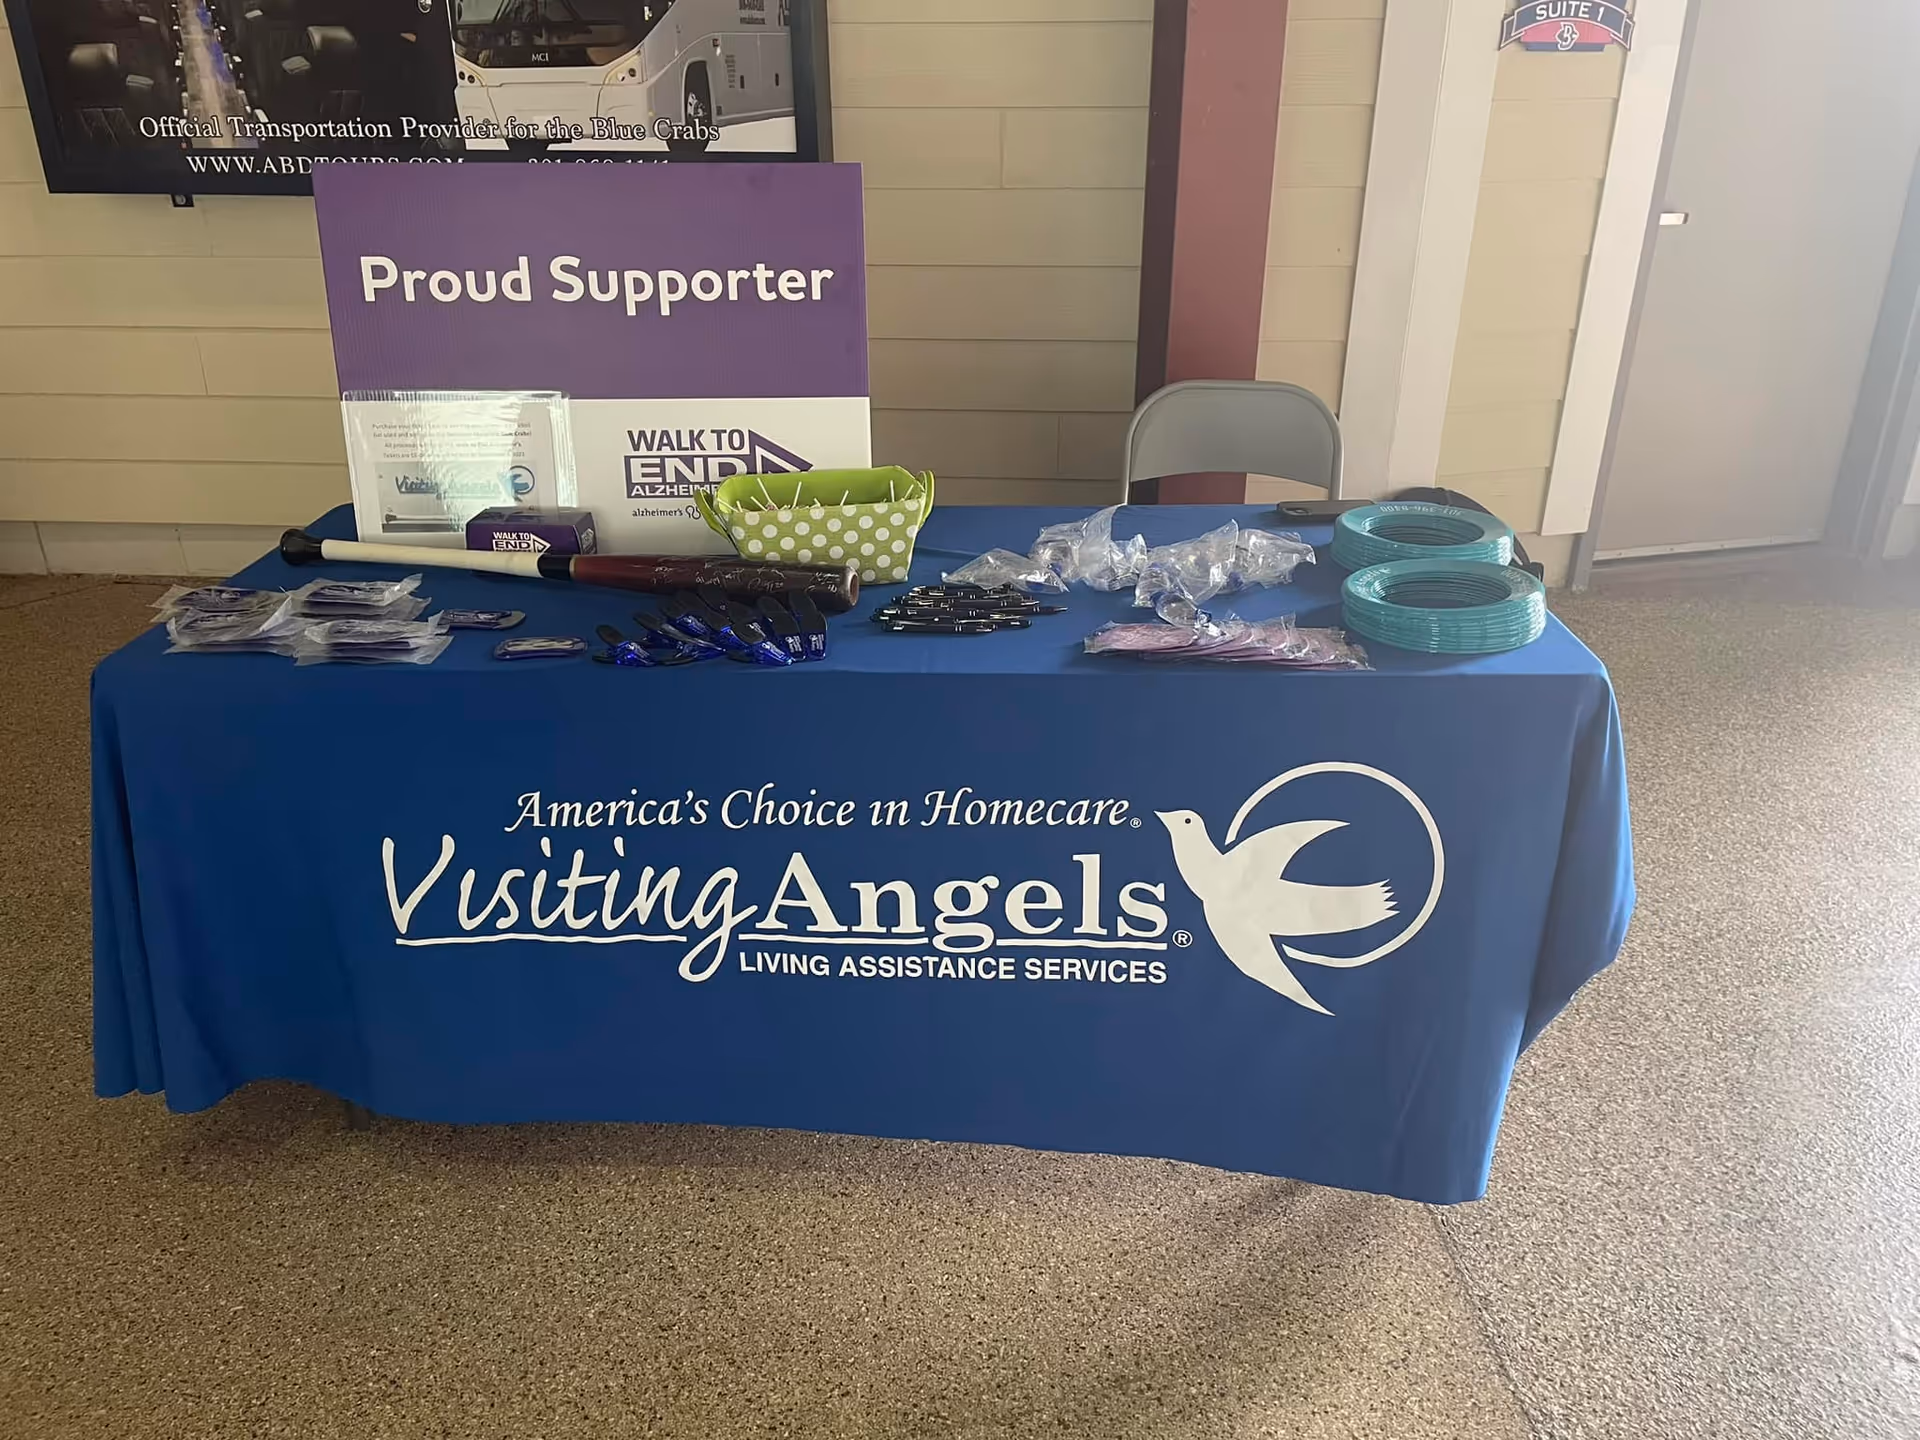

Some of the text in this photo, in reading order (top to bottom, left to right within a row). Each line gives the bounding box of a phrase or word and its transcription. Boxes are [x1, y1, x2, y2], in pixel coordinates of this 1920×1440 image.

[1535, 1, 1605, 21] SUITE 1
[531, 52, 549, 62] MCI
[139, 116, 720, 142] Official Transportation Provider for the Blue Crabs
[359, 255, 834, 316] Proud Supporter
[627, 428, 745, 452] WALK TO
[629, 457, 748, 484] END
[631, 483, 720, 497] ALZHEI
[632, 508, 683, 518] alzheimer's
[492, 531, 530, 540] WALK TO
[494, 540, 530, 549] END
[504, 790, 709, 832] America's
[721, 782, 855, 829] Choice
[869, 797, 910, 827] in
[382, 834, 758, 982] Visiting
[739, 952, 1168, 984] LIVING ASSISTANCE SERVICES
